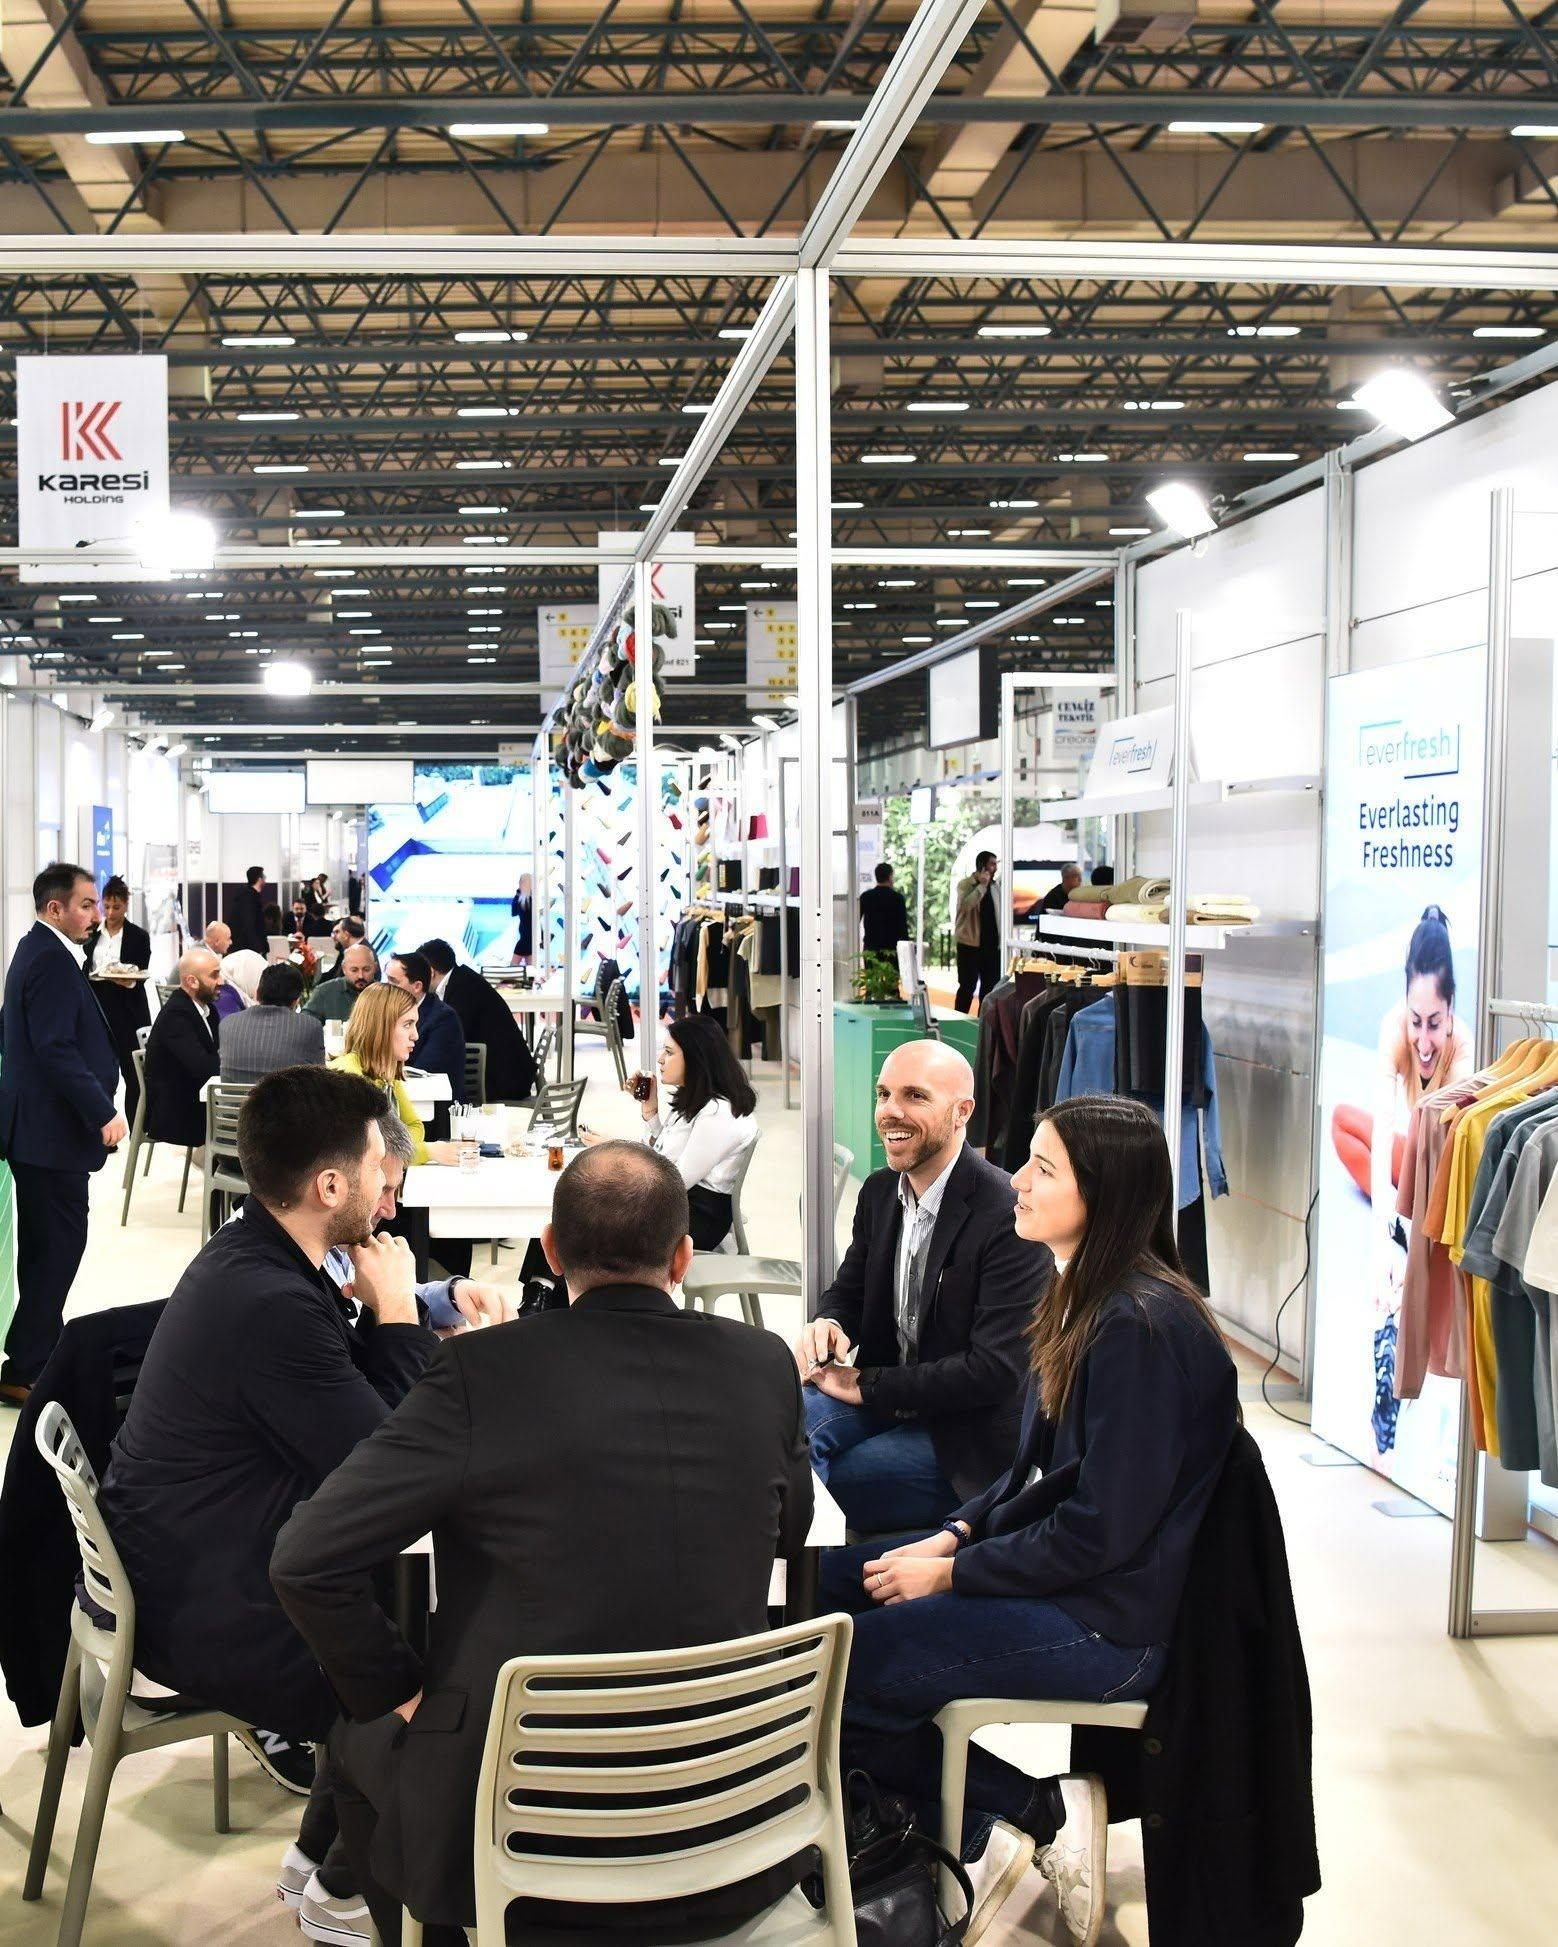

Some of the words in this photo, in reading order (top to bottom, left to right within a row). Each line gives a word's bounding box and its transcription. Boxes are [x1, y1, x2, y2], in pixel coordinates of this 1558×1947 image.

[1366, 727, 1451, 766] everfresh
[1359, 794, 1460, 833] Everlasting
[1363, 838, 1454, 868] Freshness
